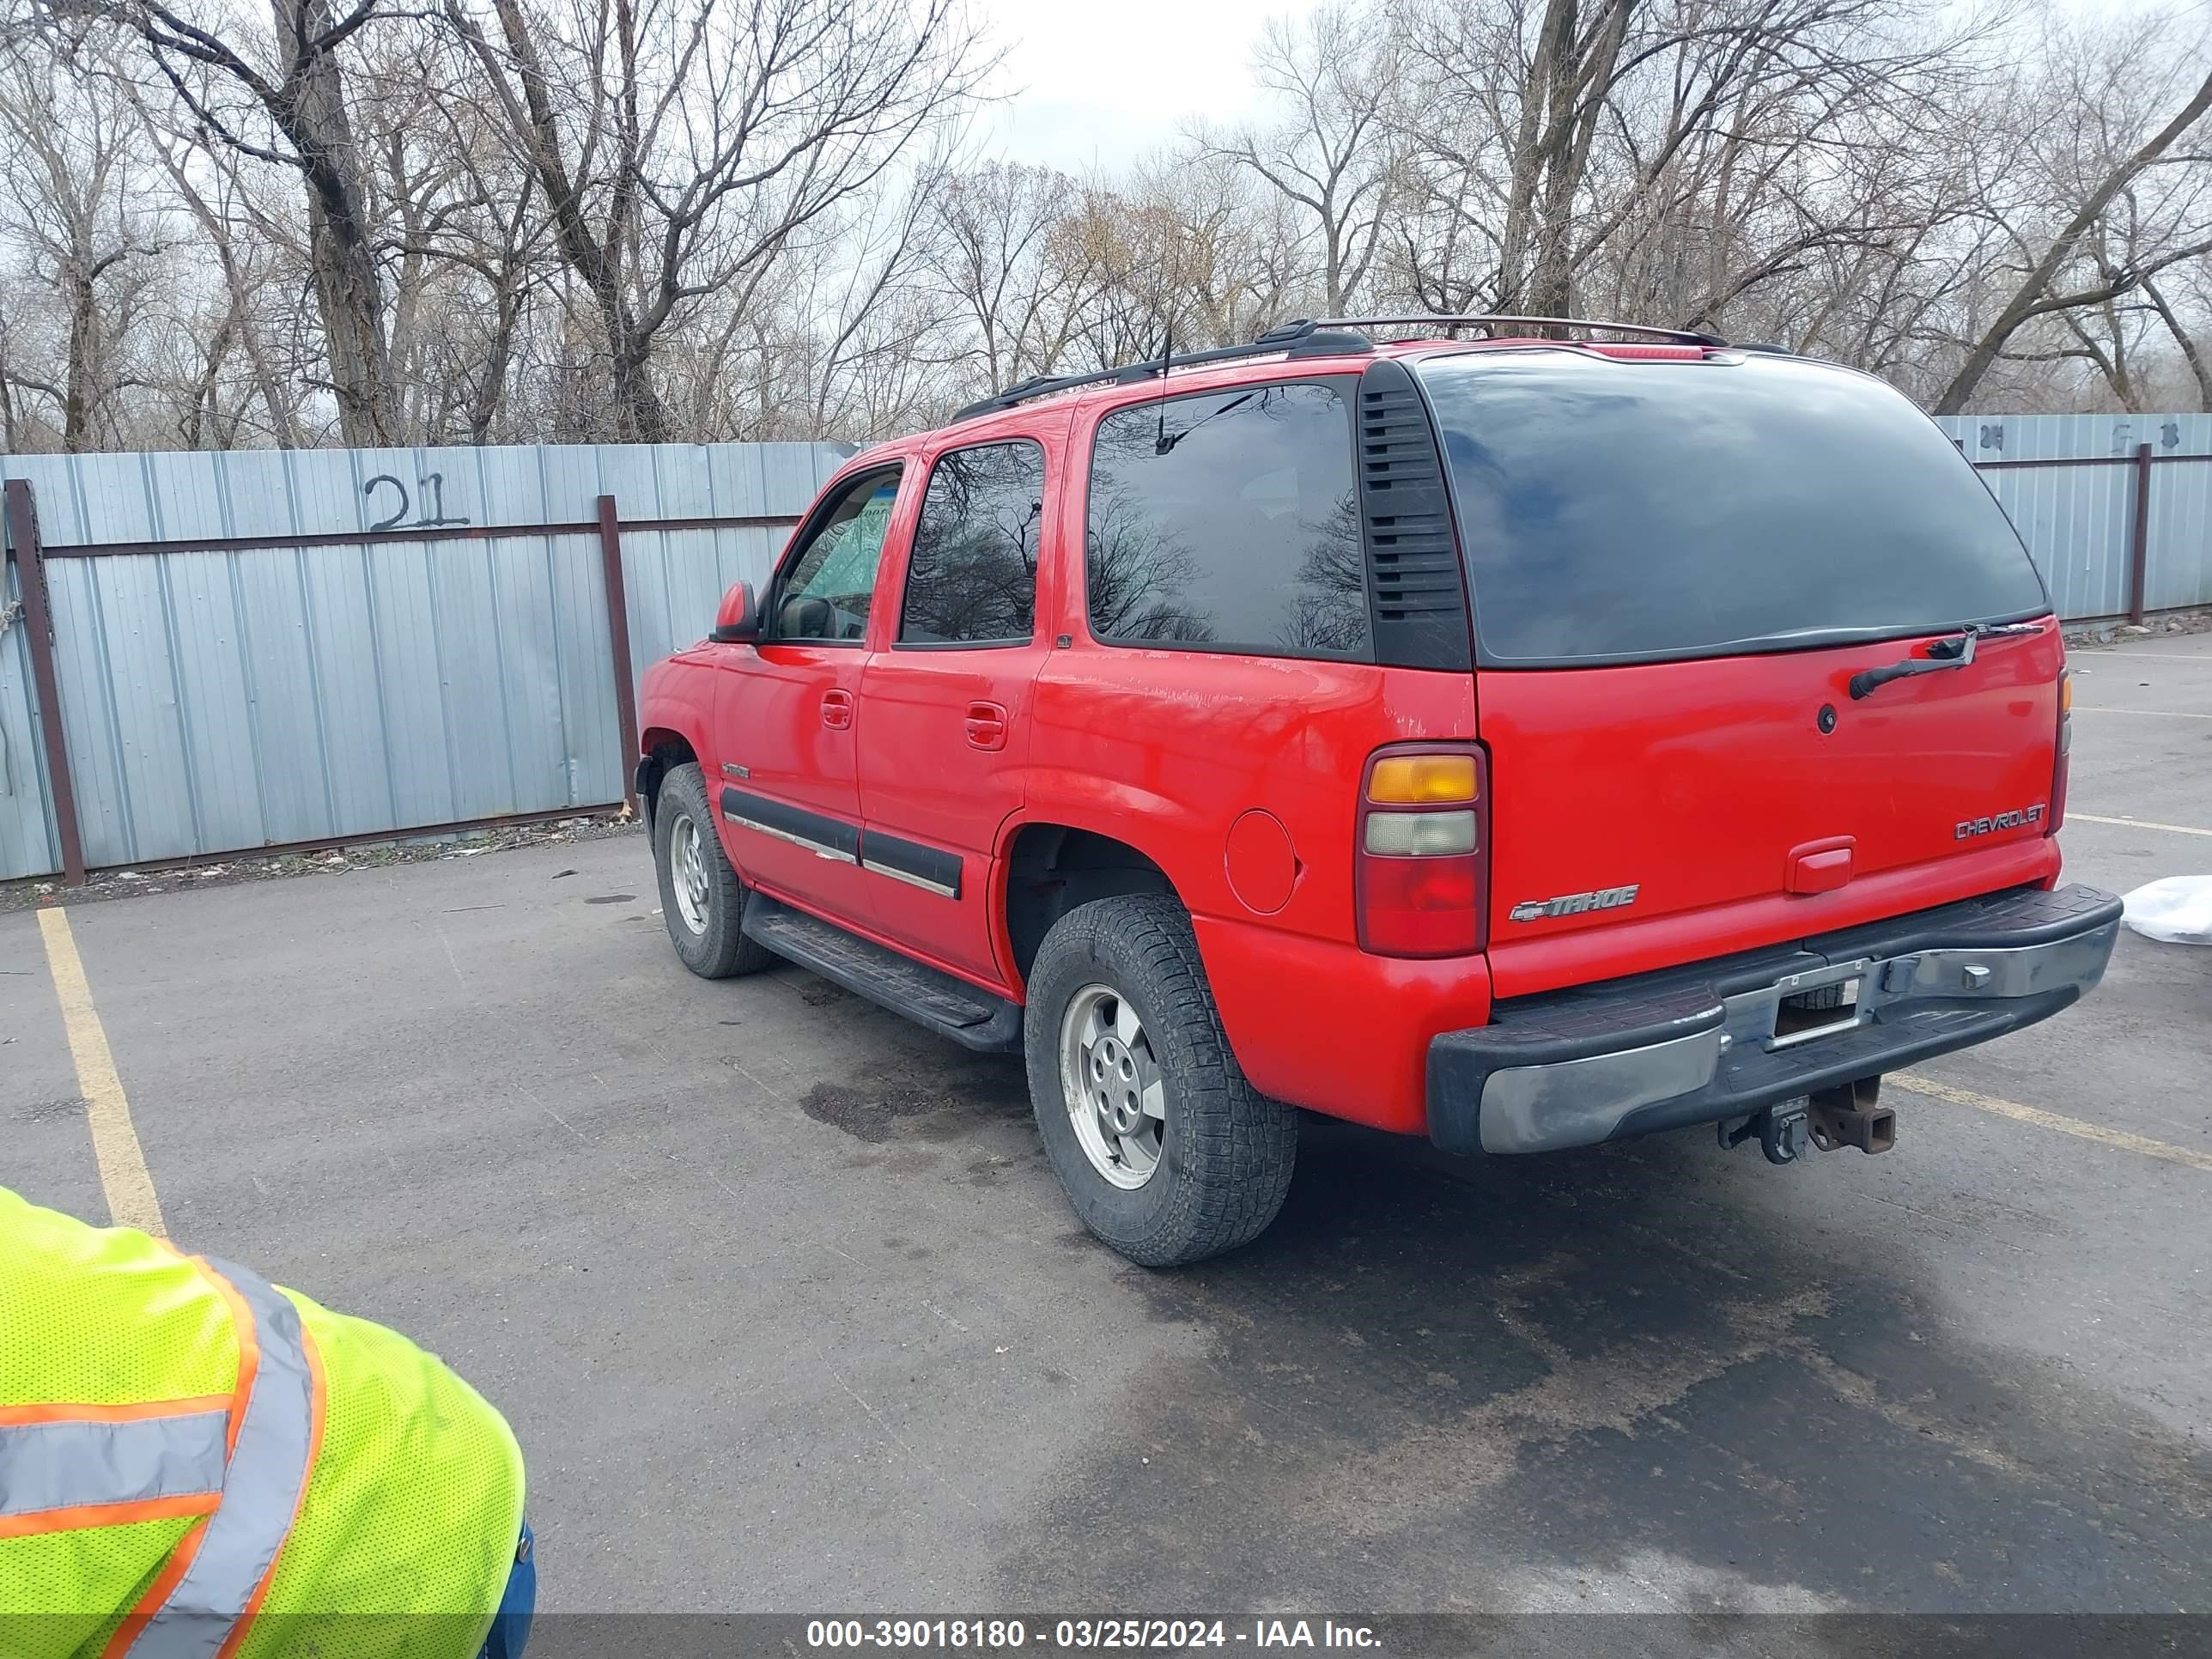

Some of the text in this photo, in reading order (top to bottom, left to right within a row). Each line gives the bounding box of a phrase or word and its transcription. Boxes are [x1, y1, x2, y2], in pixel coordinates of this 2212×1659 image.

[365, 472, 470, 532] 21
[1955, 804, 2045, 839] CHEVROLET
[1548, 884, 1640, 916] TAHOE
